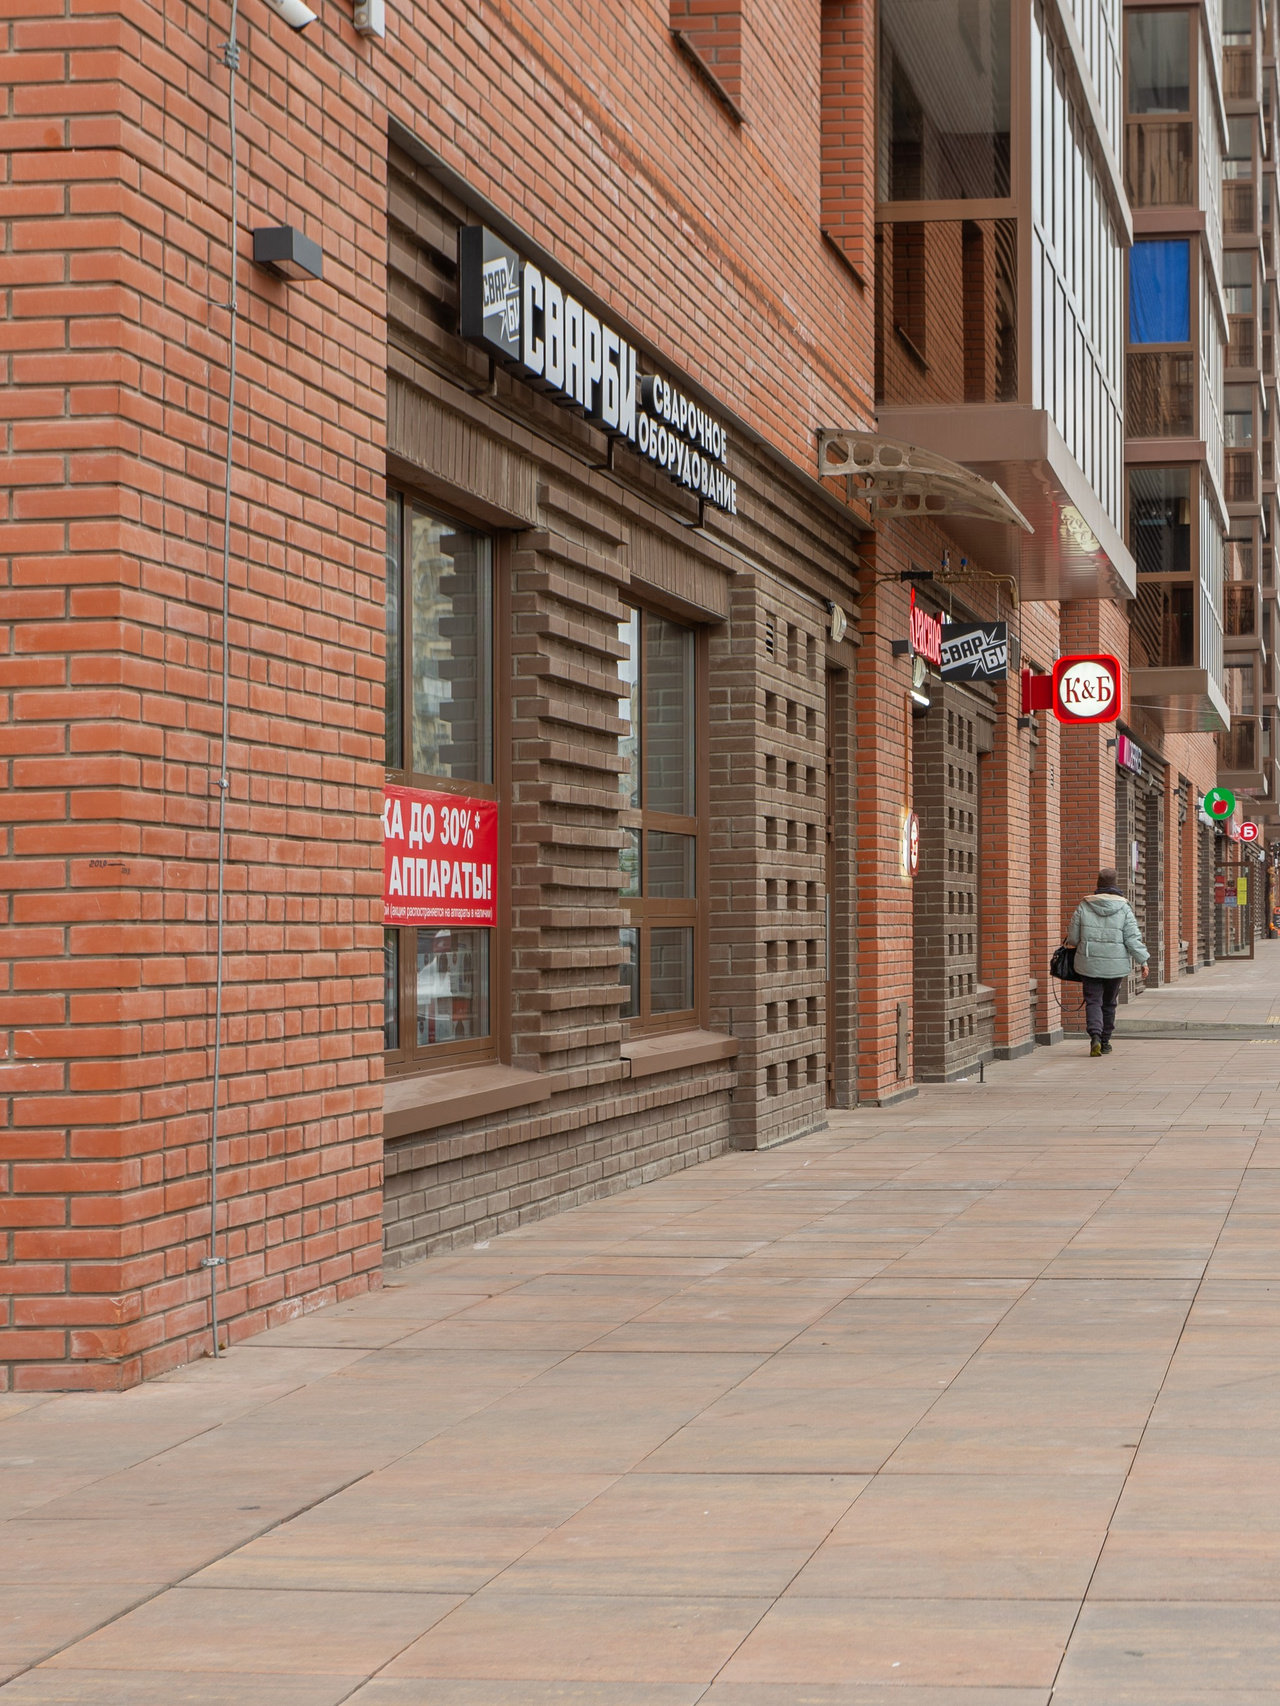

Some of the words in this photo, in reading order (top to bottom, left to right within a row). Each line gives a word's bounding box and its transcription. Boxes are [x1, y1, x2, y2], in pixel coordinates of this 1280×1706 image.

[483, 268, 507, 307] СВАР
[524, 261, 636, 443] СВАРБИ
[653, 374, 727, 465] СВАРОЧНОЕ
[638, 411, 737, 516] ОБОРУДОВАНИЕ
[941, 635, 983, 667] СВАР
[1064, 676, 1111, 703] К&Б
[409, 802, 435, 850] ДО
[1243, 826, 1254, 837] Б
[389, 856, 492, 900] АППАРАТЫ!
